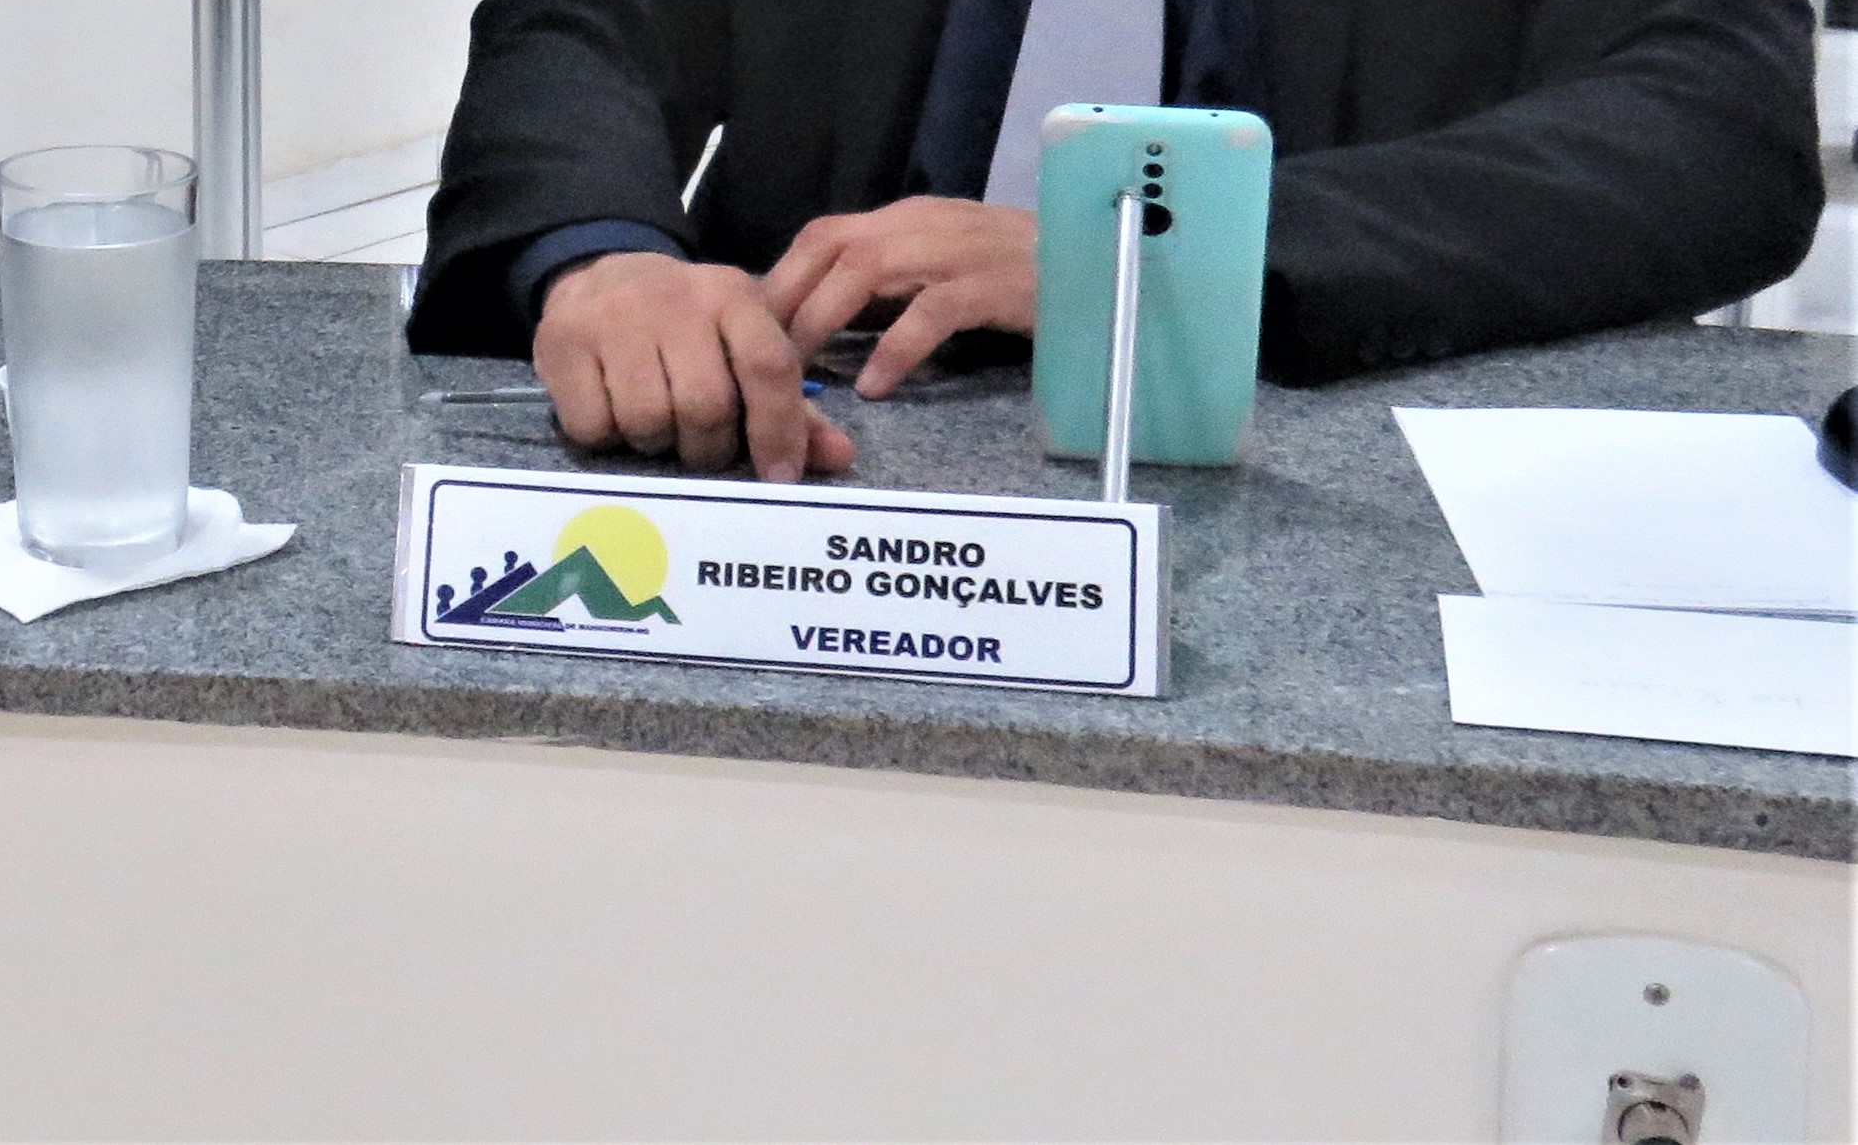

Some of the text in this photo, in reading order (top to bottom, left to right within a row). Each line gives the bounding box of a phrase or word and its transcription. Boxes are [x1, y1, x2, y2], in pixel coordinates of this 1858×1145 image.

[826, 534, 986, 569] SANDRO
[698, 561, 1103, 610] RIBEIRO GONÇALVES
[790, 624, 1002, 663] VEREADOR
